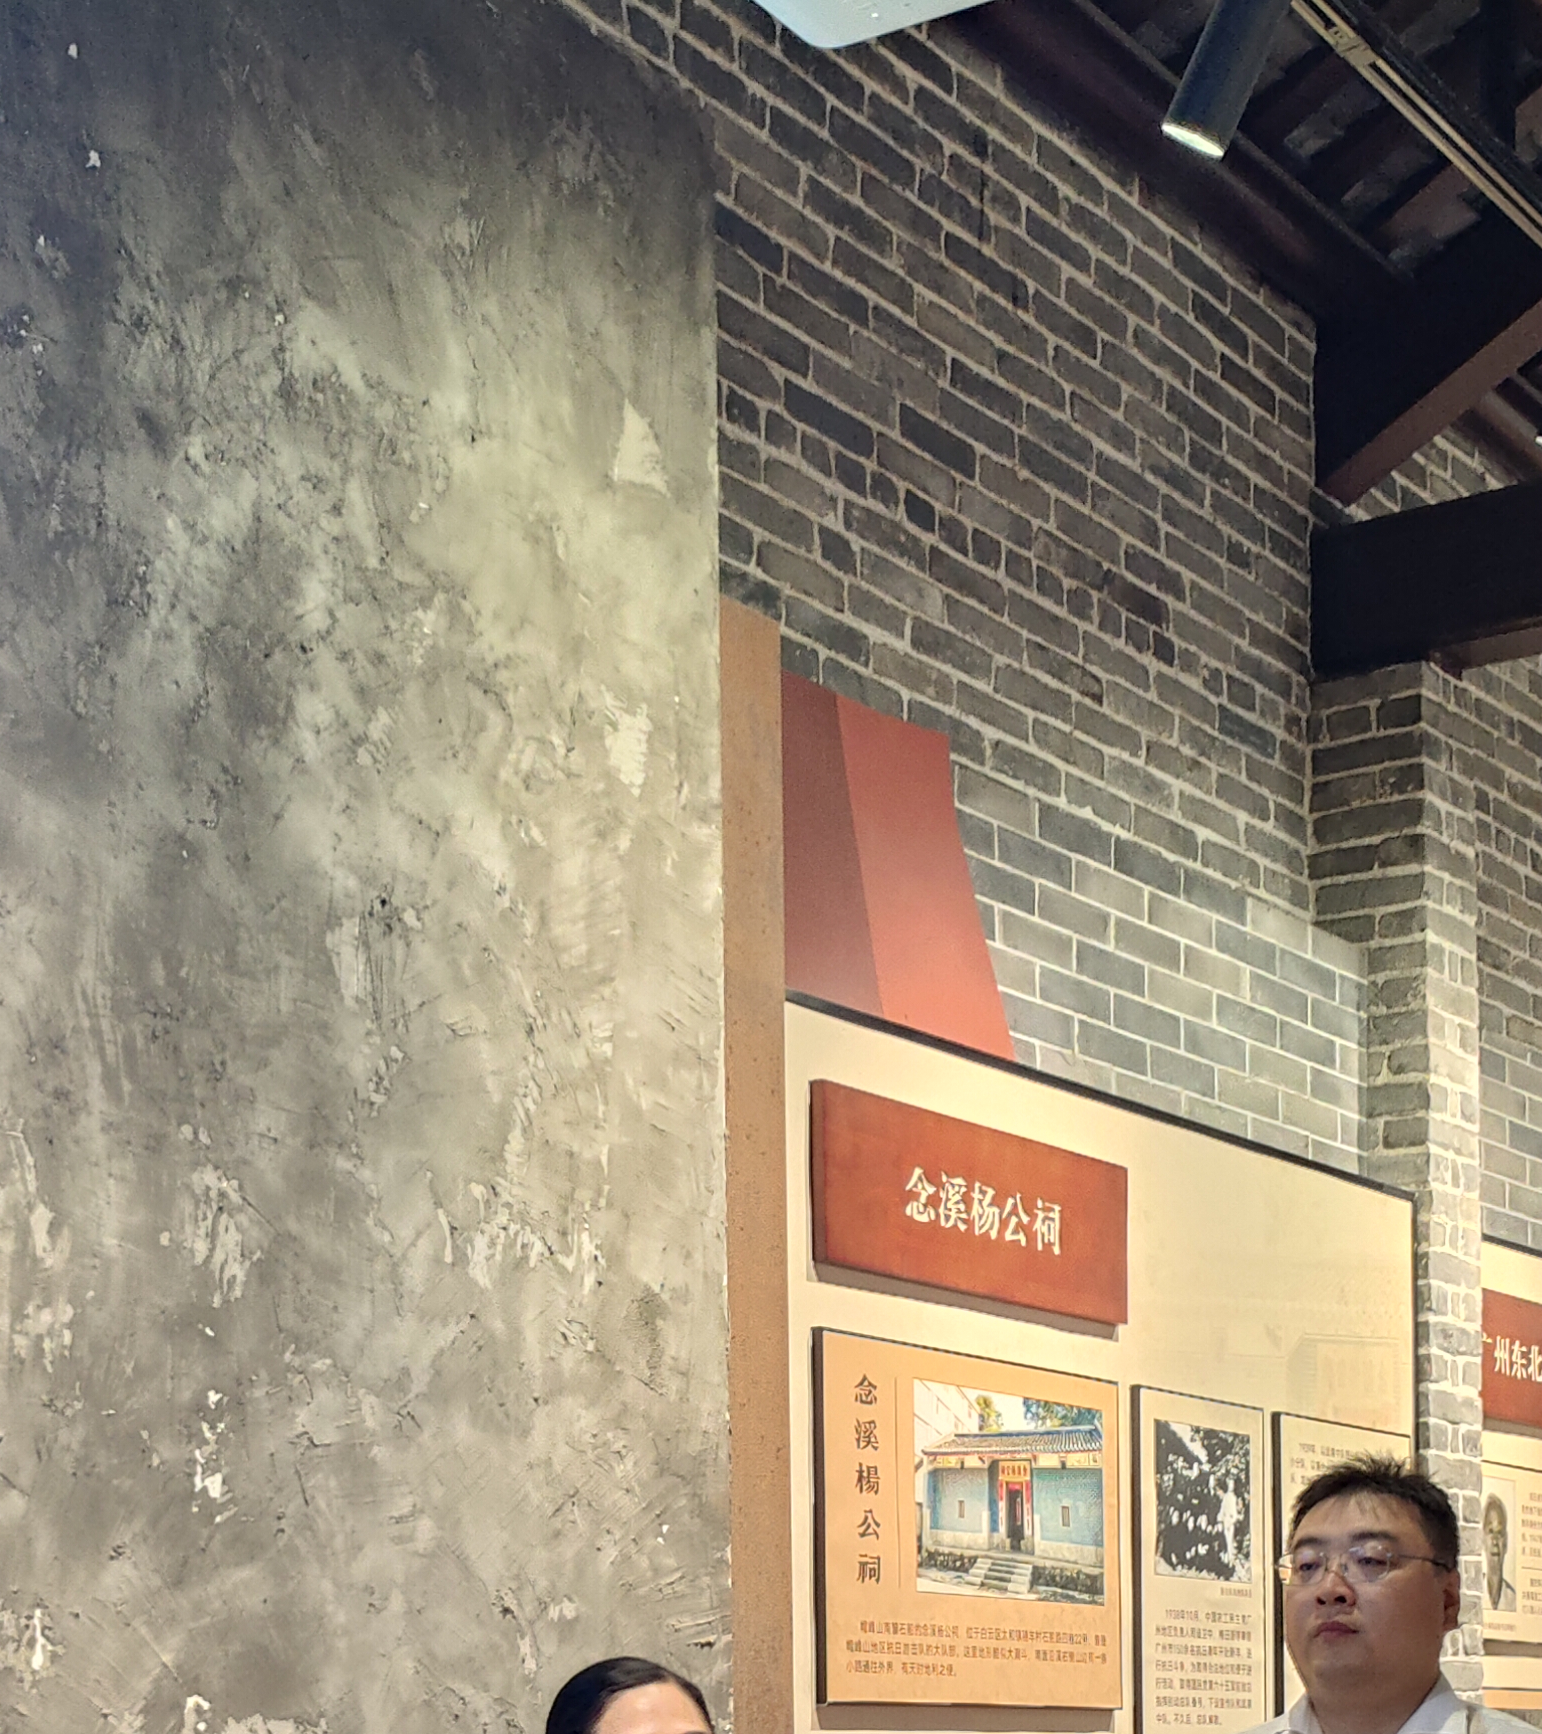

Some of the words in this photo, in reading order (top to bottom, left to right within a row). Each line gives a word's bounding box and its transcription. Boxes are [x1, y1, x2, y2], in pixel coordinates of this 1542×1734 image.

[905, 1165, 1062, 1256] 念溪杨公祠
[853, 1373, 881, 1586] 念溪楊公祠
